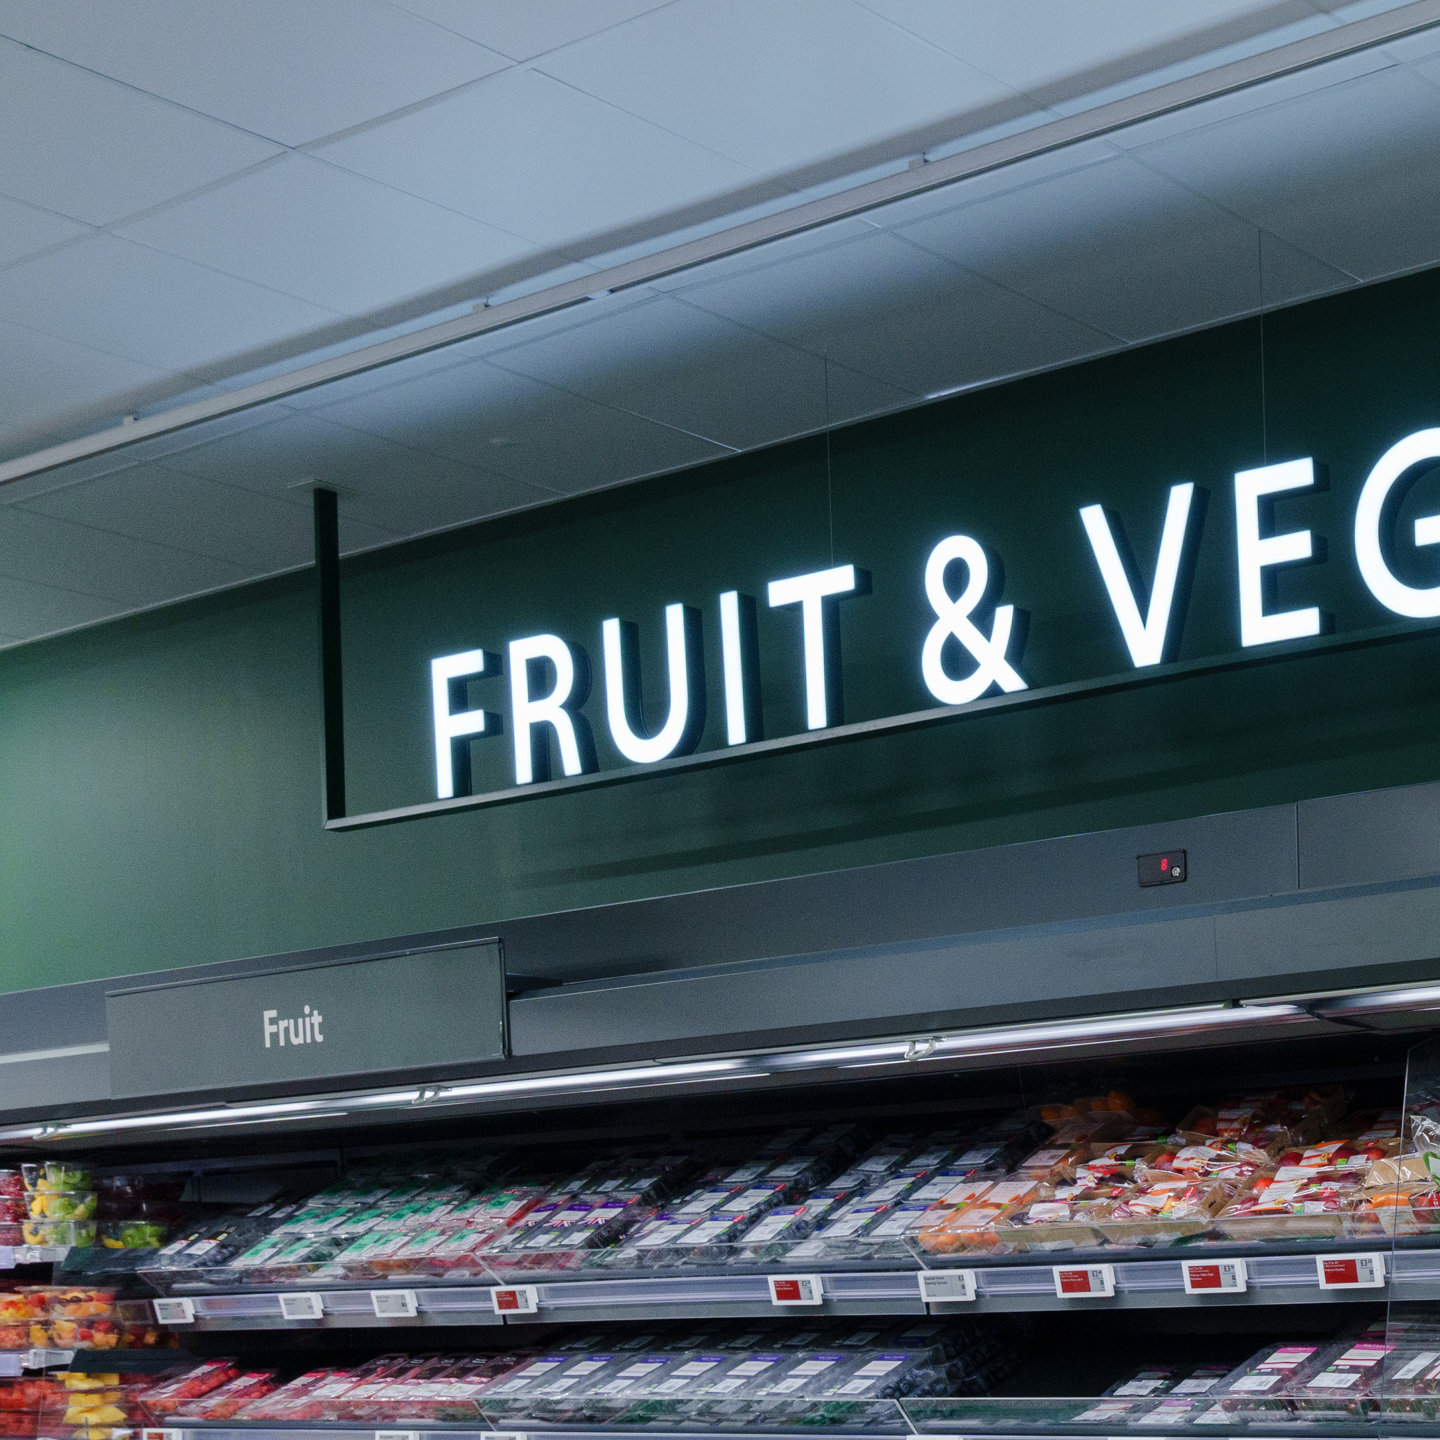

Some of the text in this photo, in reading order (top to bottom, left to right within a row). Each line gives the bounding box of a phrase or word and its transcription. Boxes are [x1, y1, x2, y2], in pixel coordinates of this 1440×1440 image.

[430, 563, 858, 800] FRUIT
[921, 535, 1029, 706] &
[1161, 858, 1168, 871] 8
[262, 1004, 323, 1049] Fruit
